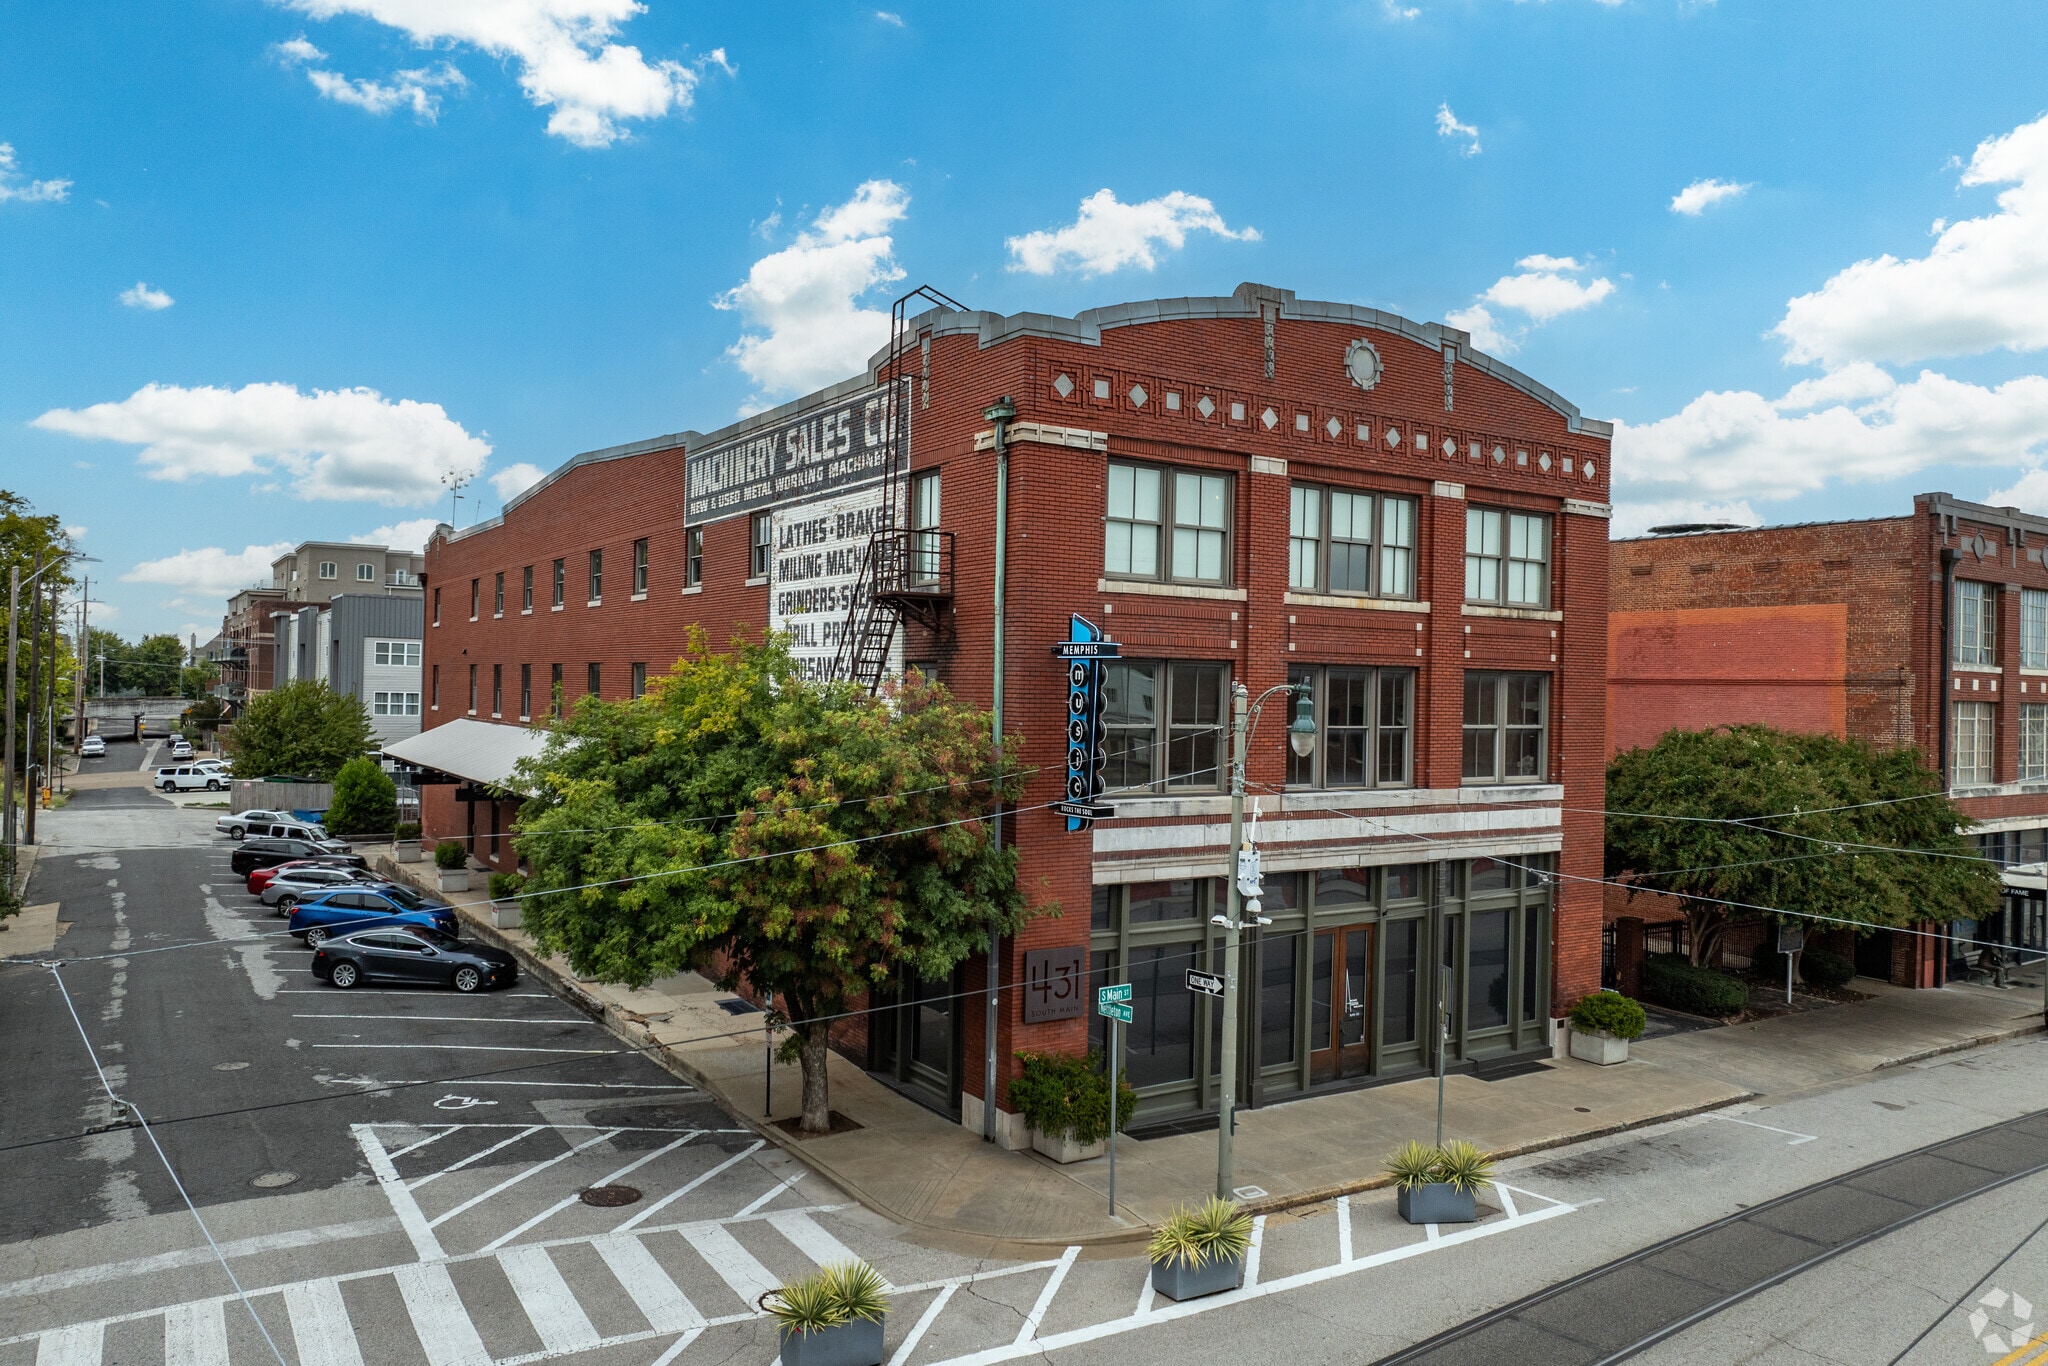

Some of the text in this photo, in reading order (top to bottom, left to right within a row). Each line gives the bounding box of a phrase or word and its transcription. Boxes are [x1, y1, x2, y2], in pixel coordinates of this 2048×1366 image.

[690, 433, 780, 498] MACHINERY
[785, 409, 851, 470] SALES
[690, 500, 708, 516] NEW
[718, 490, 741, 507] USED
[743, 484, 772, 501] METAL
[775, 467, 824, 492] WORKING
[778, 553, 822, 583] MILLING
[1062, 644, 1098, 656] MEMPHIS
[1061, 805, 1074, 813] ROCKS
[1082, 808, 1093, 816] SOUL
[2010, 889, 2030, 897] FAME
[1032, 959, 1080, 1004] 431
[1190, 976, 1214, 987] ONE WAY
[1101, 988, 1129, 1001] S Main ST
[1031, 1005, 1079, 1018] SOUTH MAIN
[1122, 1010, 1130, 1018] AVE
